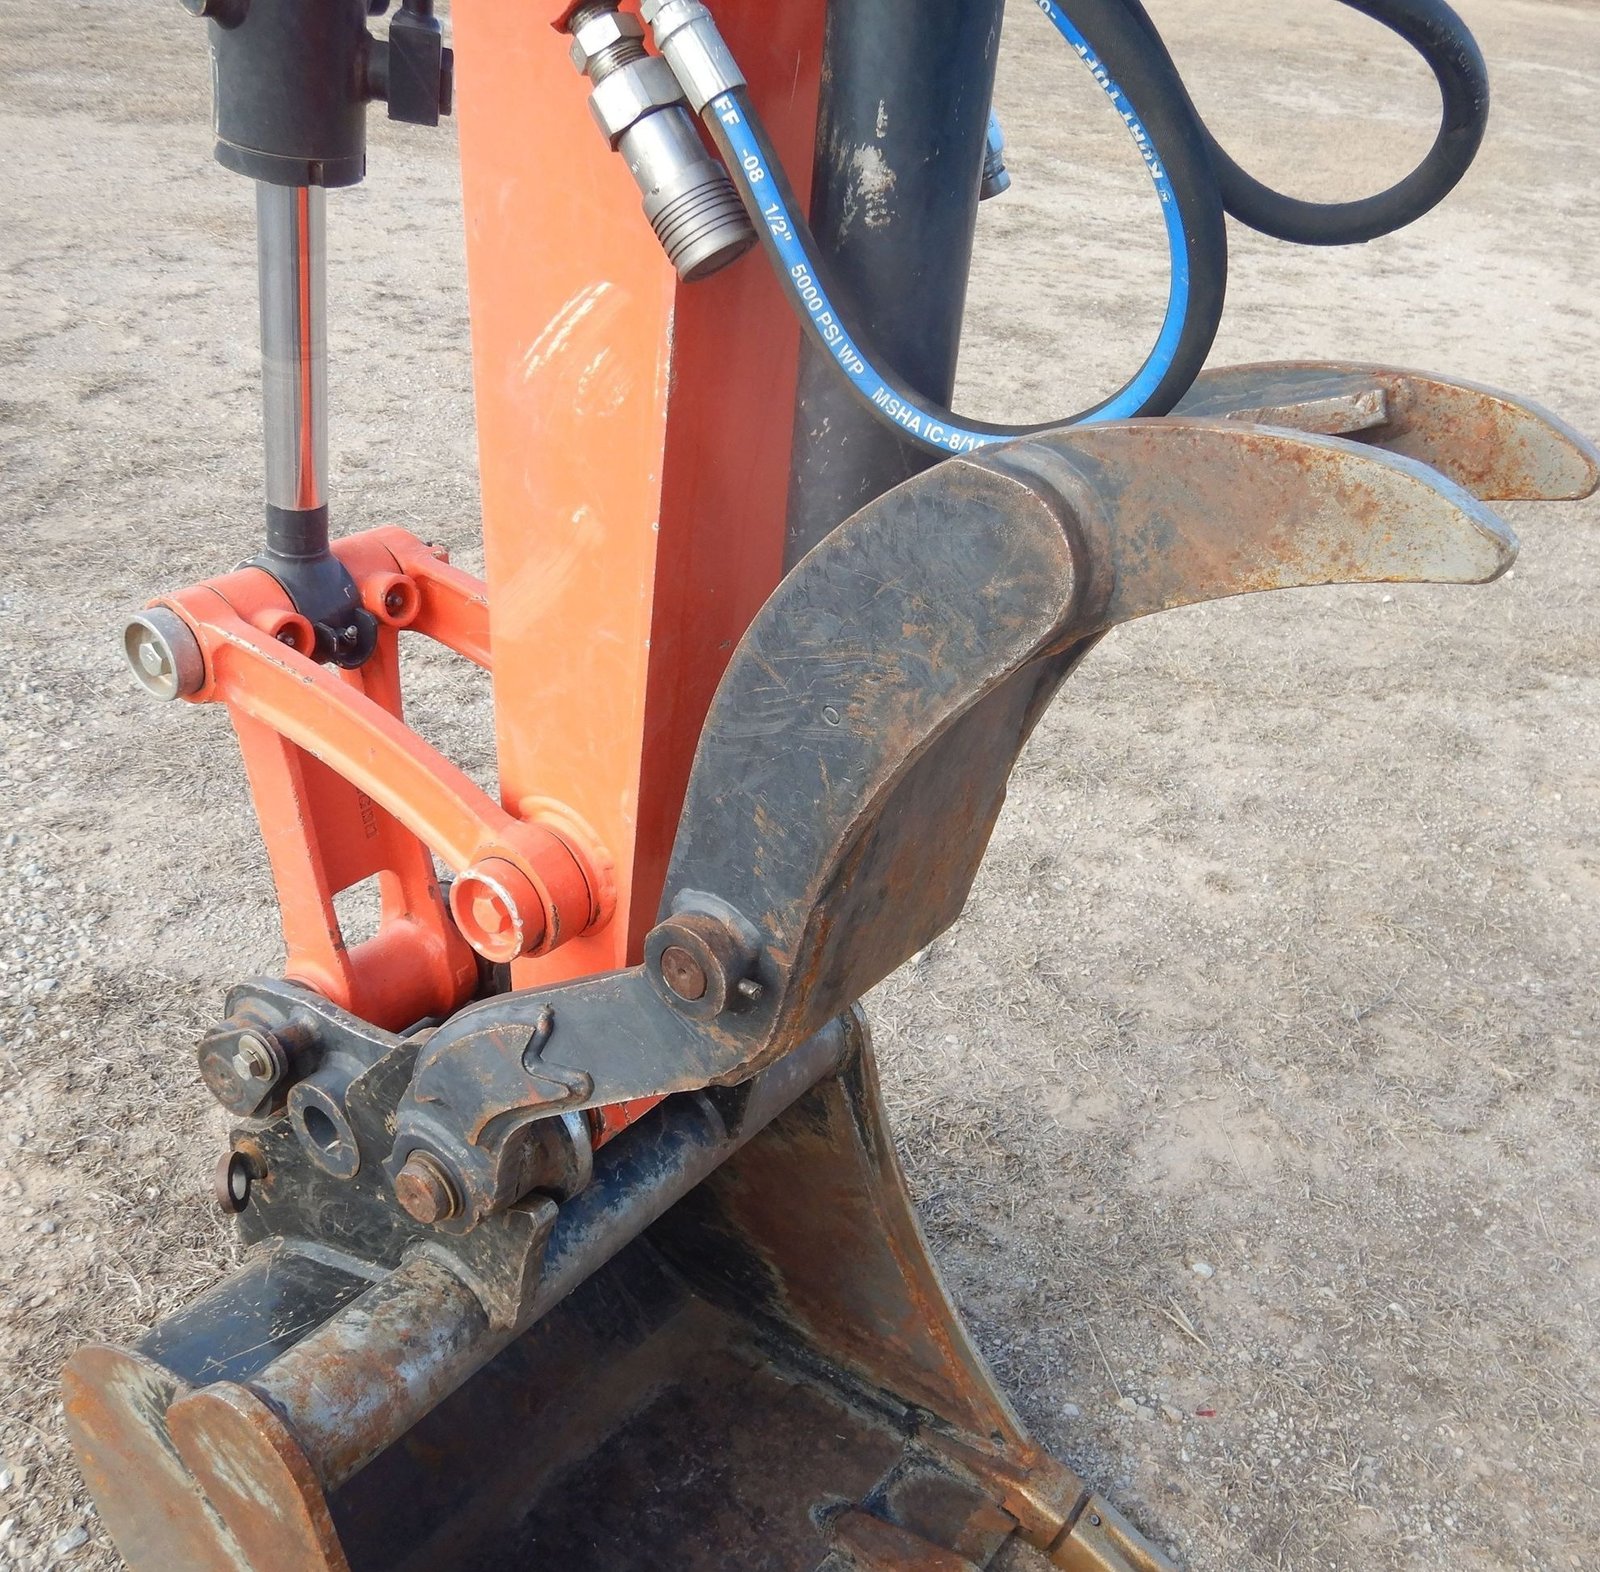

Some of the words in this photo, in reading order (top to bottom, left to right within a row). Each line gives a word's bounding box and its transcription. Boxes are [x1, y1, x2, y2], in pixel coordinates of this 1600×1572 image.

[1075, 43, 1121, 104] TUFF
[742, 148, 765, 183] -08
[764, 203, 793, 242] 1/2"
[791, 264, 823, 312] 5000
[815, 311, 844, 347] PSI
[837, 343, 865, 377] WP
[871, 387, 921, 433] MSHA
